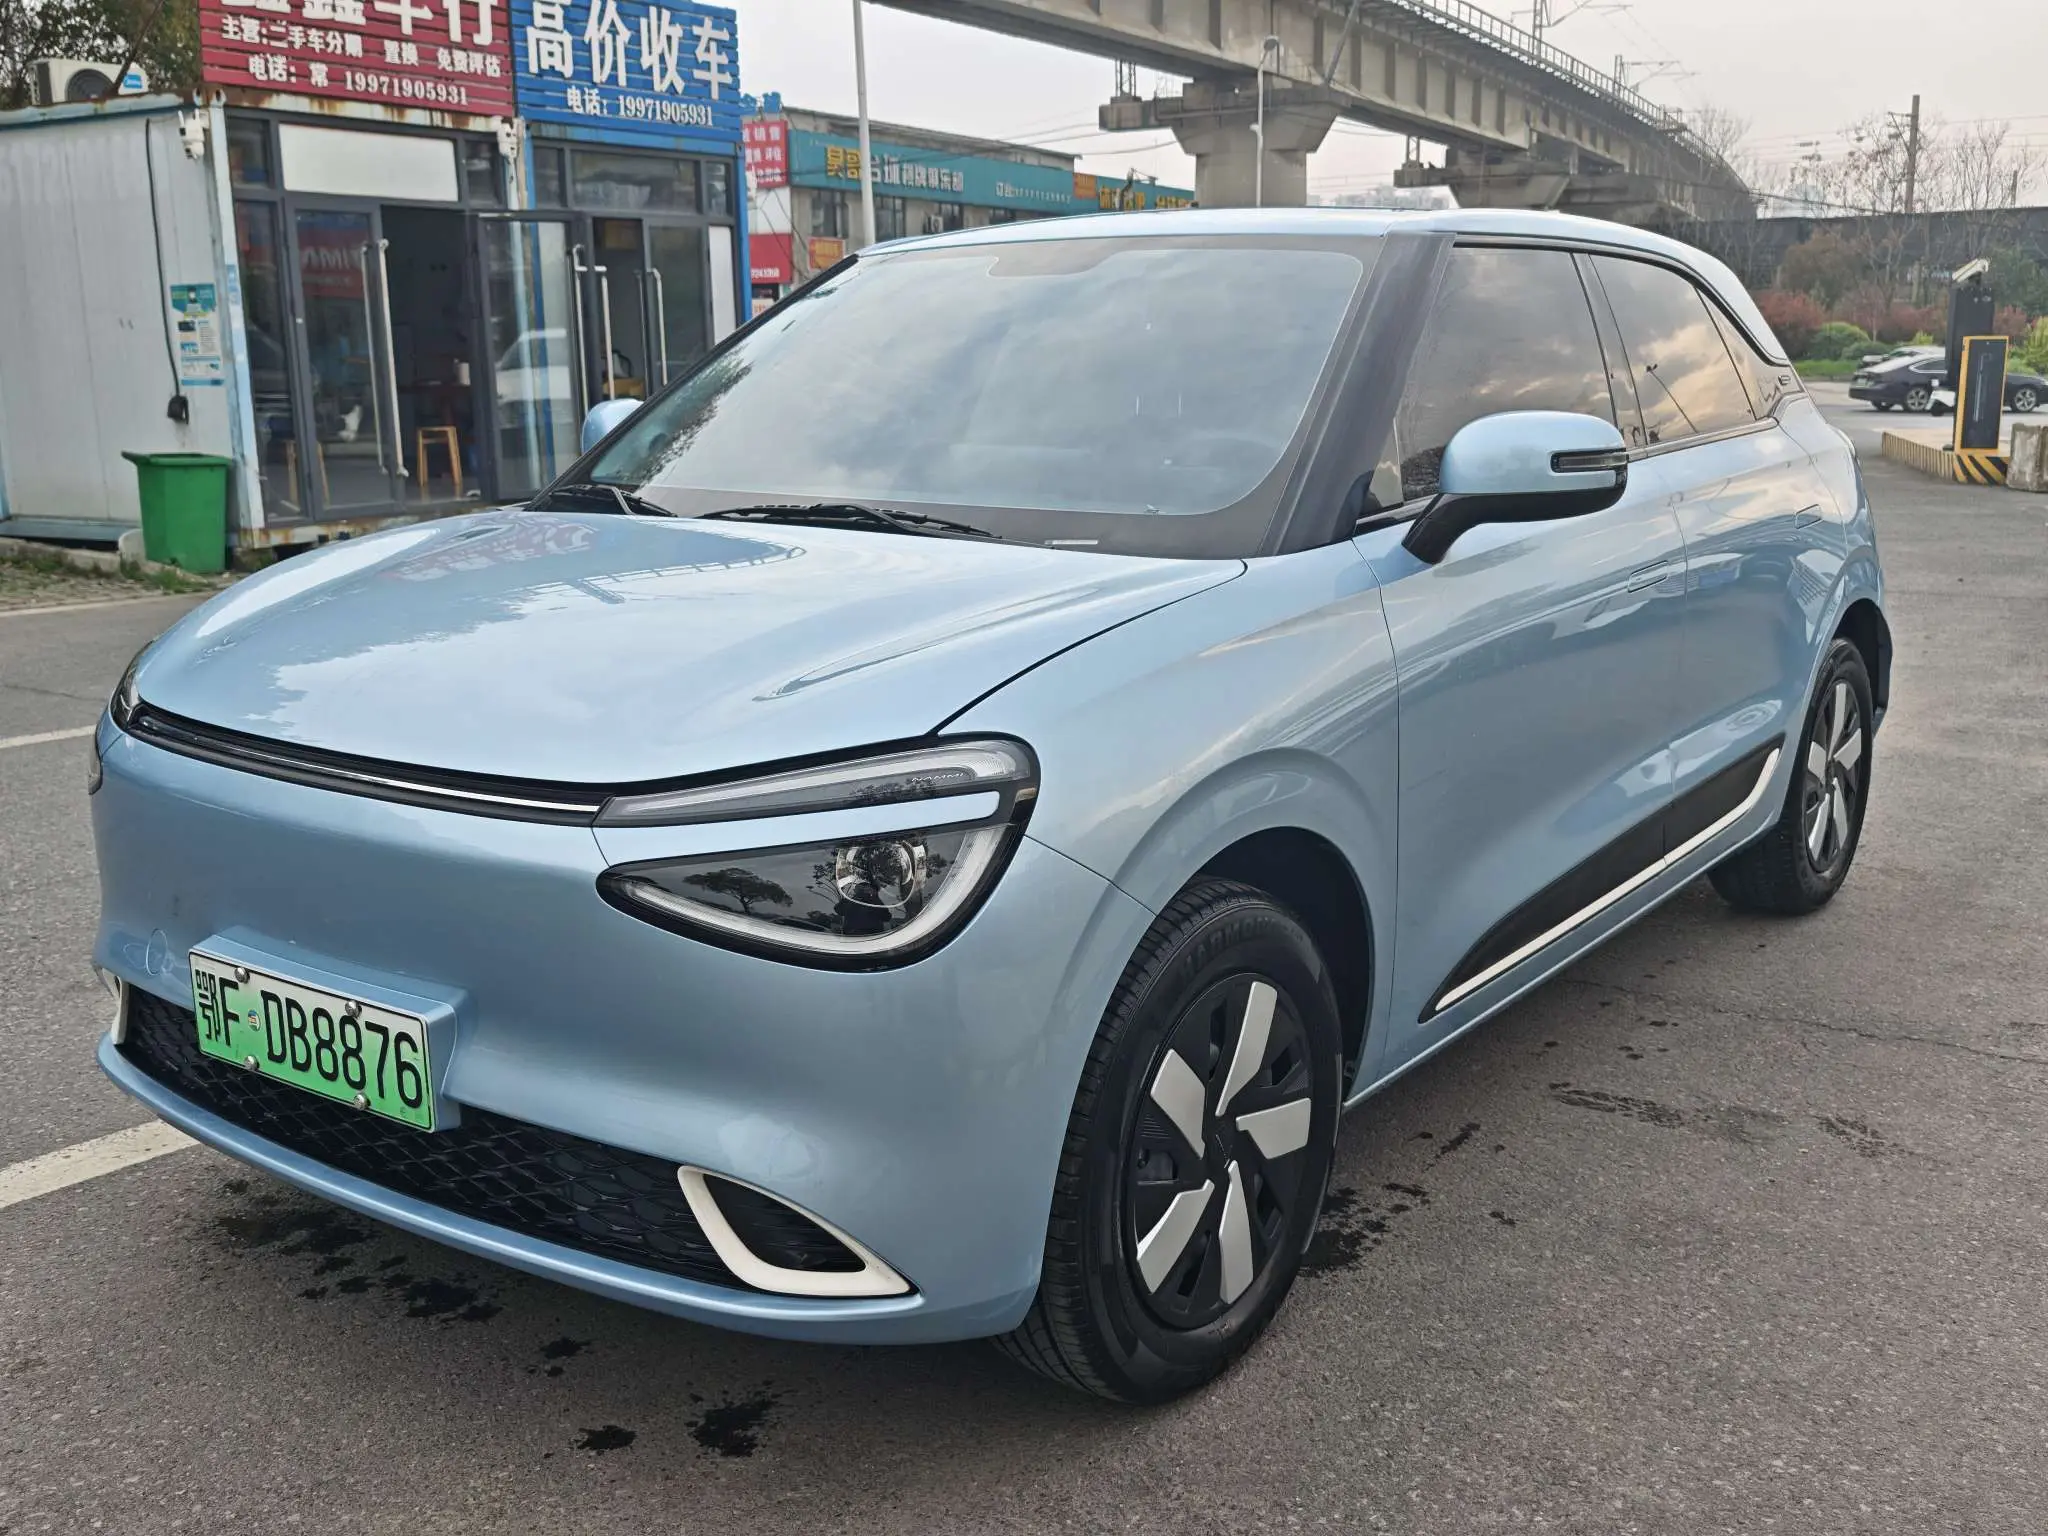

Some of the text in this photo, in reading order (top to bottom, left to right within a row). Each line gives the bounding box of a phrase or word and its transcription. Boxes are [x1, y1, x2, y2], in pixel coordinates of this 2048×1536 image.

[526, 0, 733, 100] 高价收车
[344, 70, 469, 106] 19971905931
[618, 94, 713, 127] 19971905931
[194, 968, 423, 1109] 鄂F DB8876
